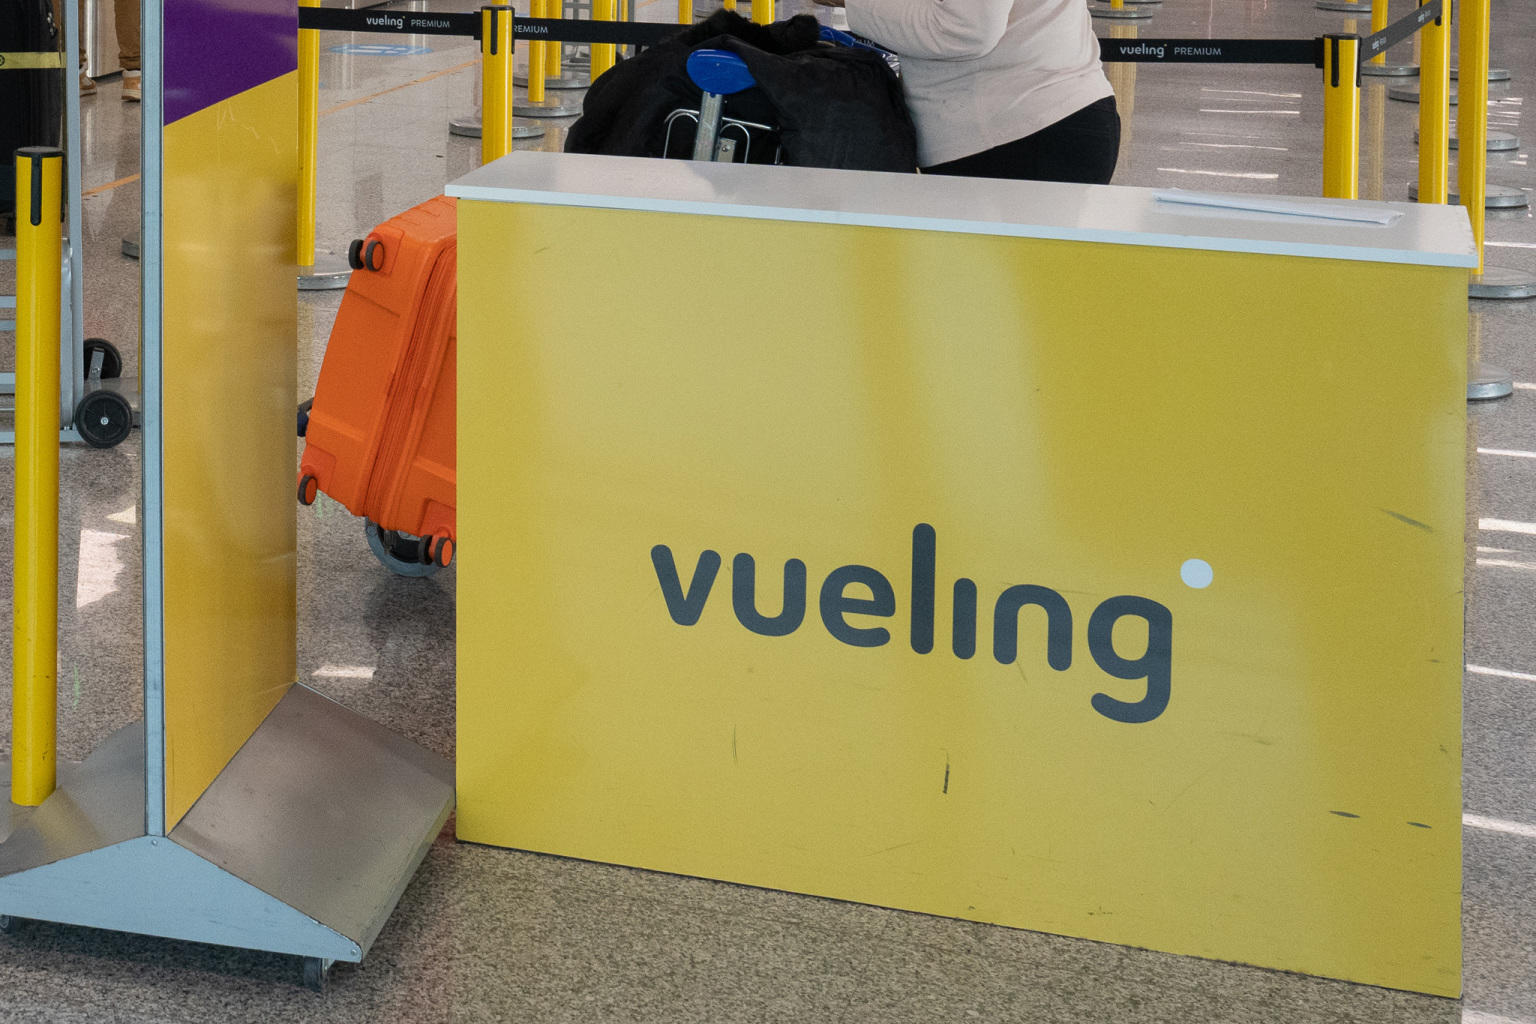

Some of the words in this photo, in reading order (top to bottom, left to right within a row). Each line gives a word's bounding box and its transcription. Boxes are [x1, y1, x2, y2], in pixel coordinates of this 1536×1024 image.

[366, 15, 403, 29] vueling
[411, 19, 450, 28] PREMIUM
[513, 24, 549, 34] REMIUM
[1119, 43, 1165, 58] vueling
[1174, 47, 1222, 56] PREMIUM
[650, 522, 1174, 724] vueling
